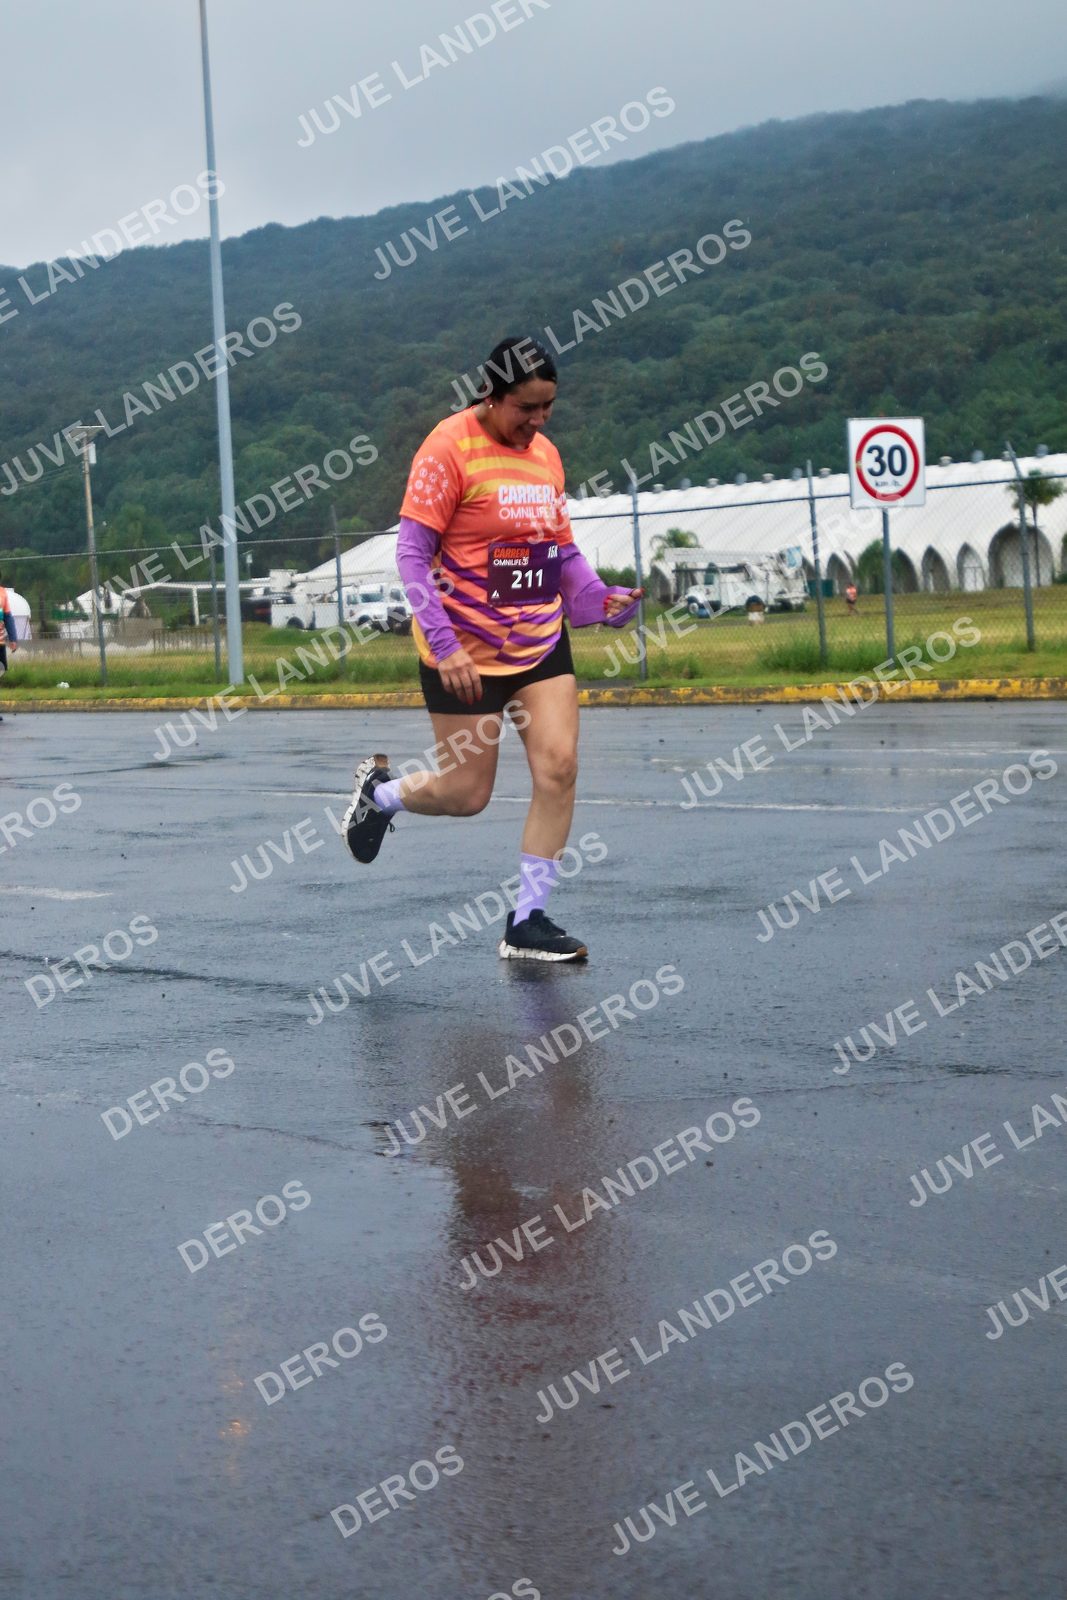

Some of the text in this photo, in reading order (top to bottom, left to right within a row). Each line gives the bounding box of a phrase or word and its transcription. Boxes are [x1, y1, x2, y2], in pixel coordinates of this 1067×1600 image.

[866, 444, 907, 476] 30
[493, 547, 530, 559] CARRERA
[511, 569, 543, 589] 211
